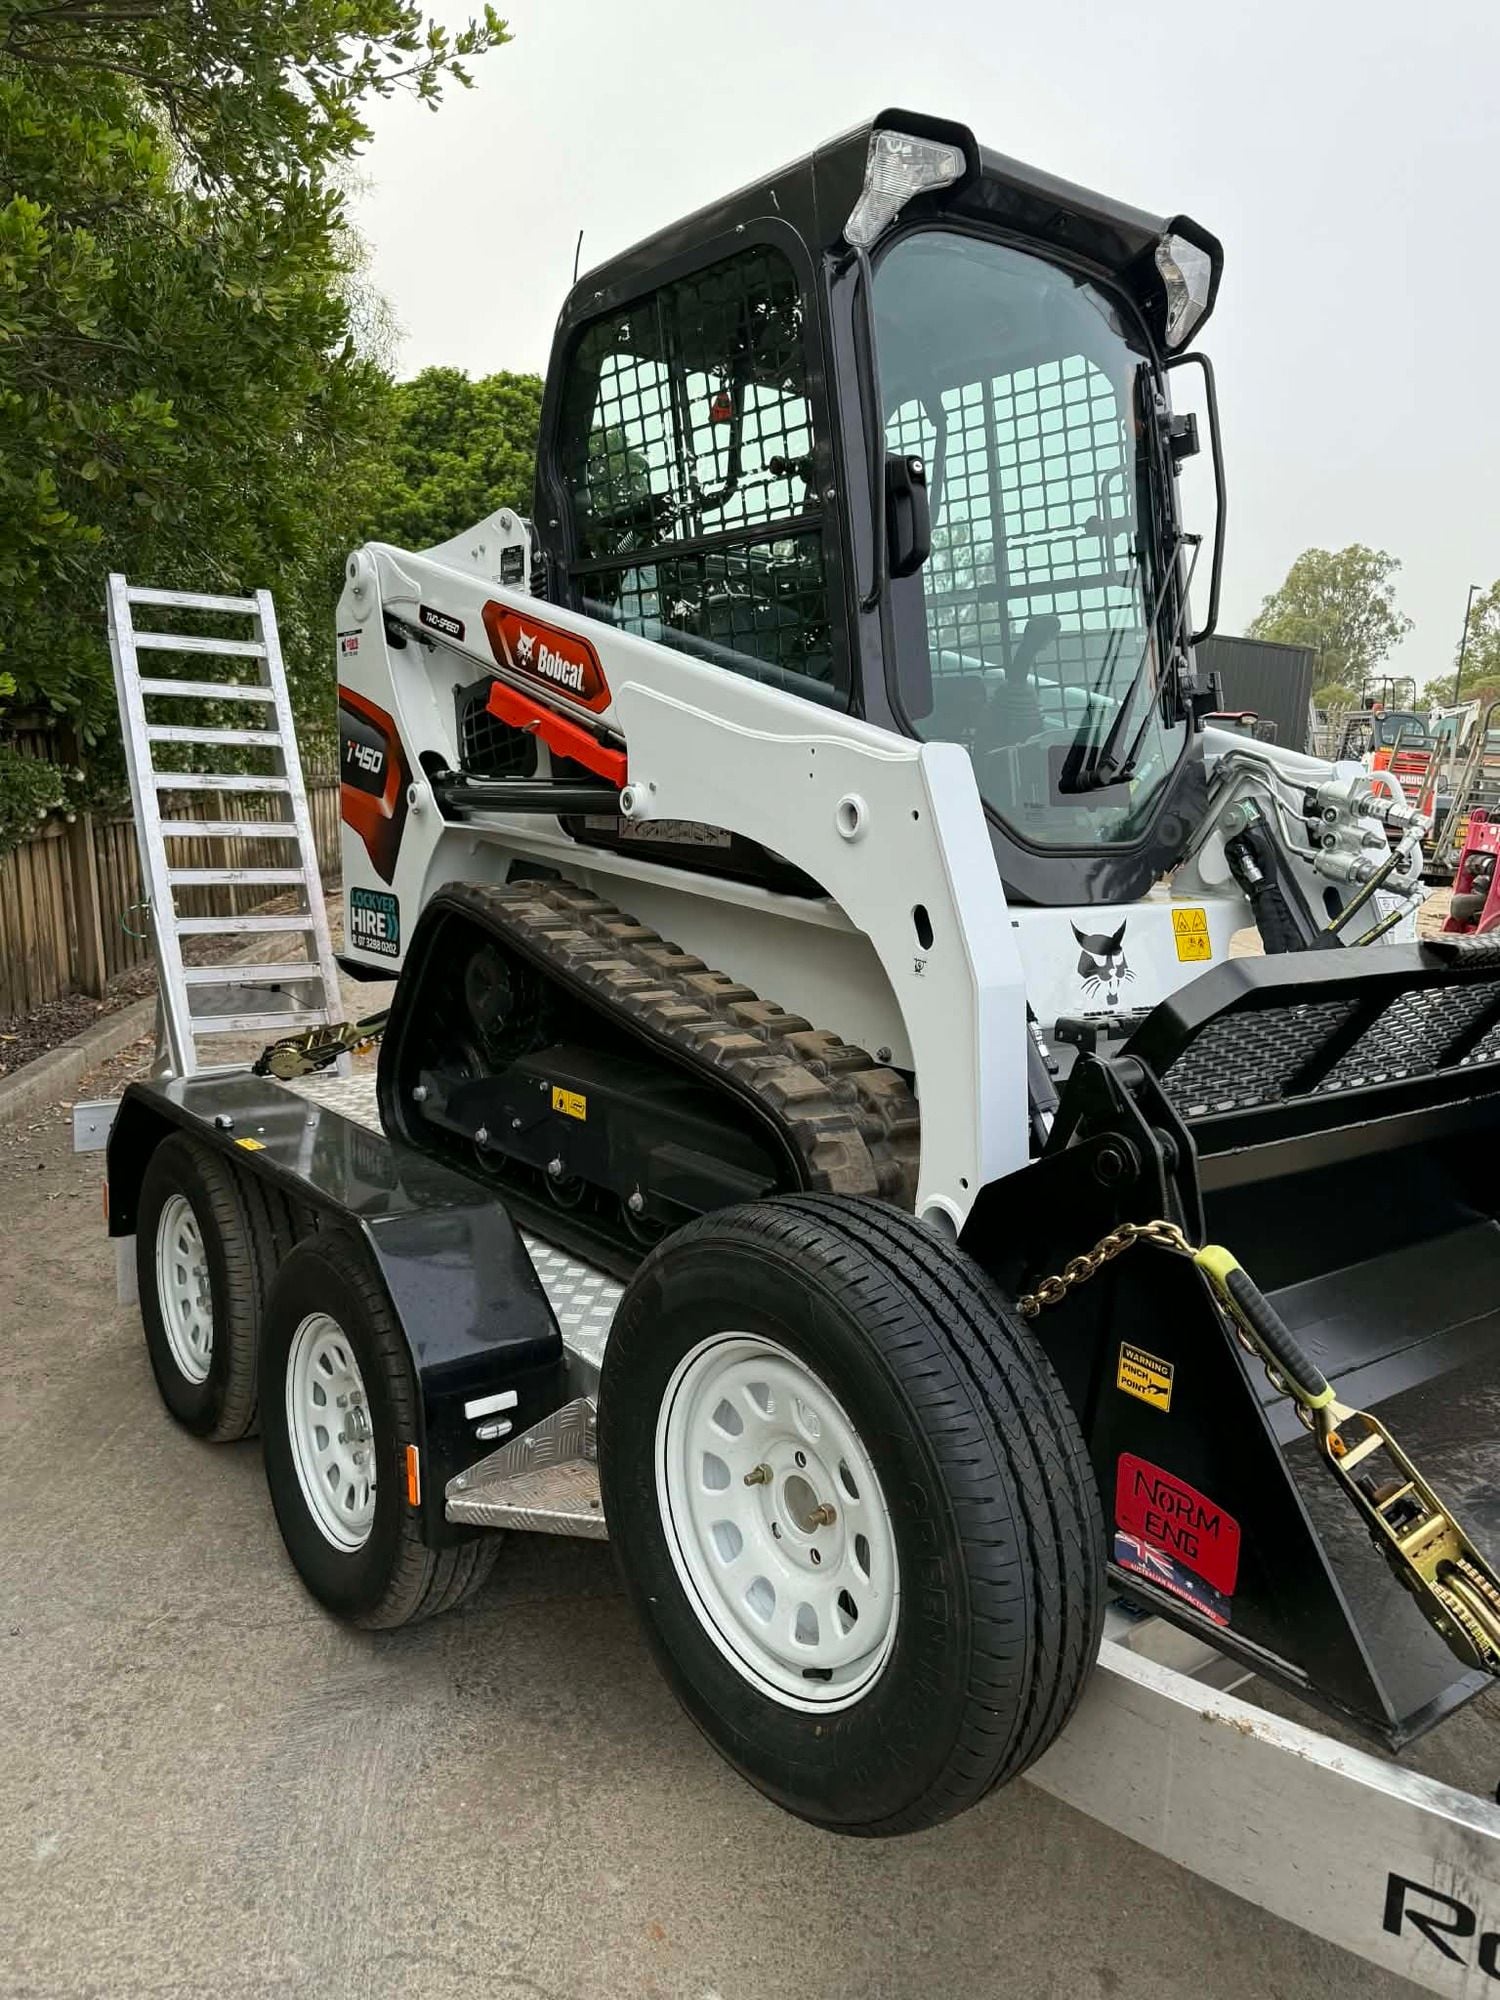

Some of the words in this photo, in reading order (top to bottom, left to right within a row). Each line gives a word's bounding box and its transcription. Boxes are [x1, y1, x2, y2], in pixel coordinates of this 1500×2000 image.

[537, 643, 585, 691] Bobcat
[346, 739, 384, 774] T450
[351, 890, 396, 914] LOCKYER
[351, 906, 387, 938] HIRE
[1122, 1362, 1149, 1381] PINCH
[1125, 1348, 1169, 1375] WARNING
[1121, 1376, 1148, 1394] POINT
[1134, 1469, 1221, 1541] NORM
[1145, 1510, 1199, 1559] ENG
